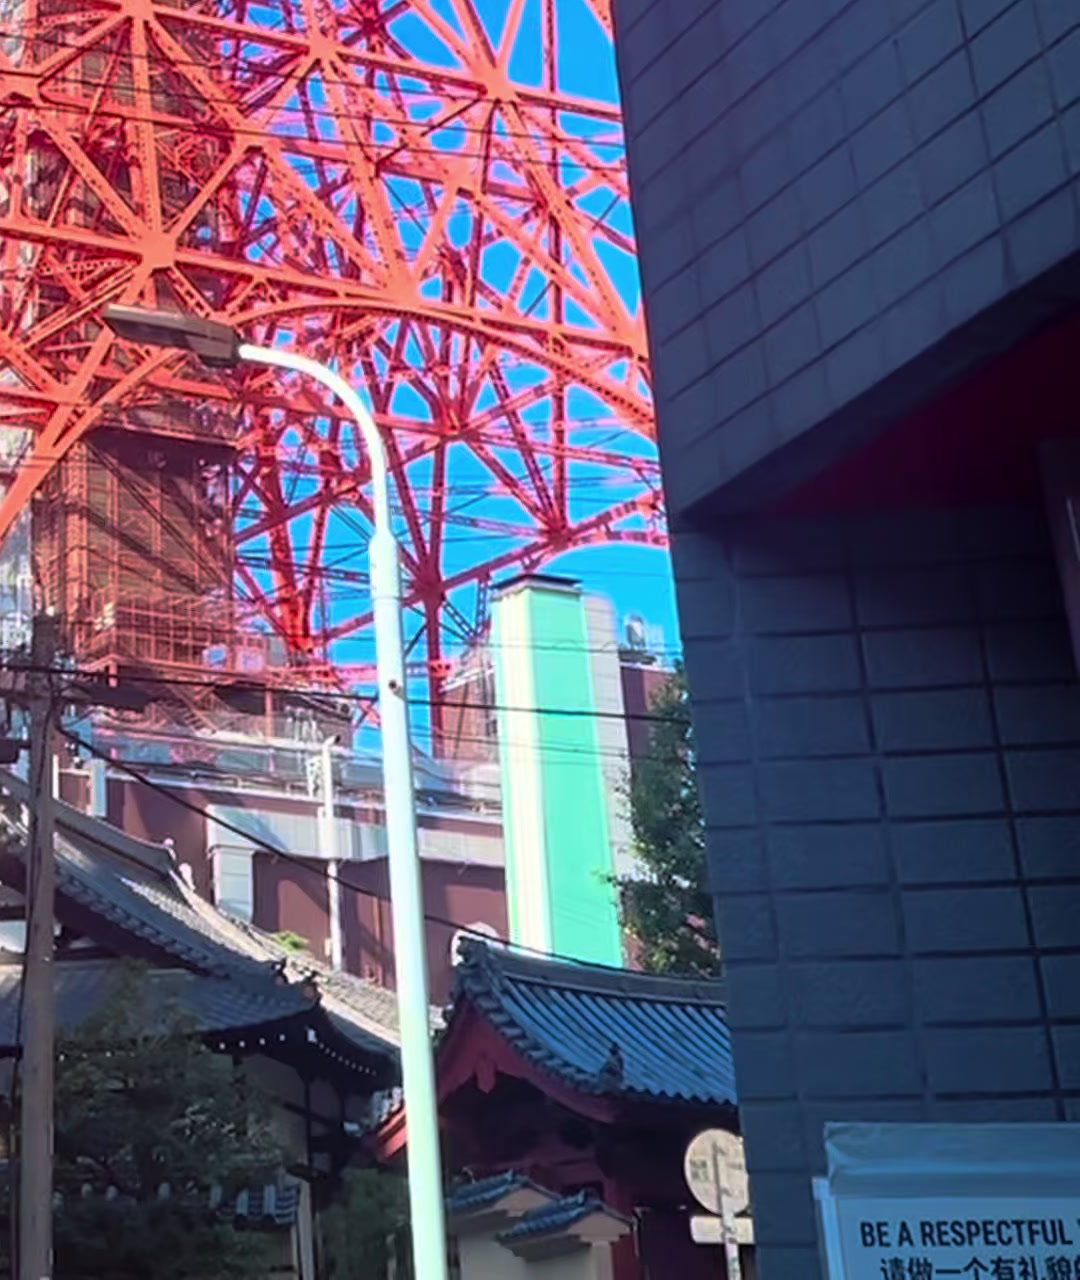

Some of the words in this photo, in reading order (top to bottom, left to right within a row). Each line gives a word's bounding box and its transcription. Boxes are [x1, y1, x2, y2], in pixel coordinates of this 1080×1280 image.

[860, 1221, 892, 1248] BE
[897, 1221, 915, 1247] A
[920, 1219, 1073, 1247] RESPECTFUL
[880, 1256, 1080, 1280] 请做一个有礼貌
